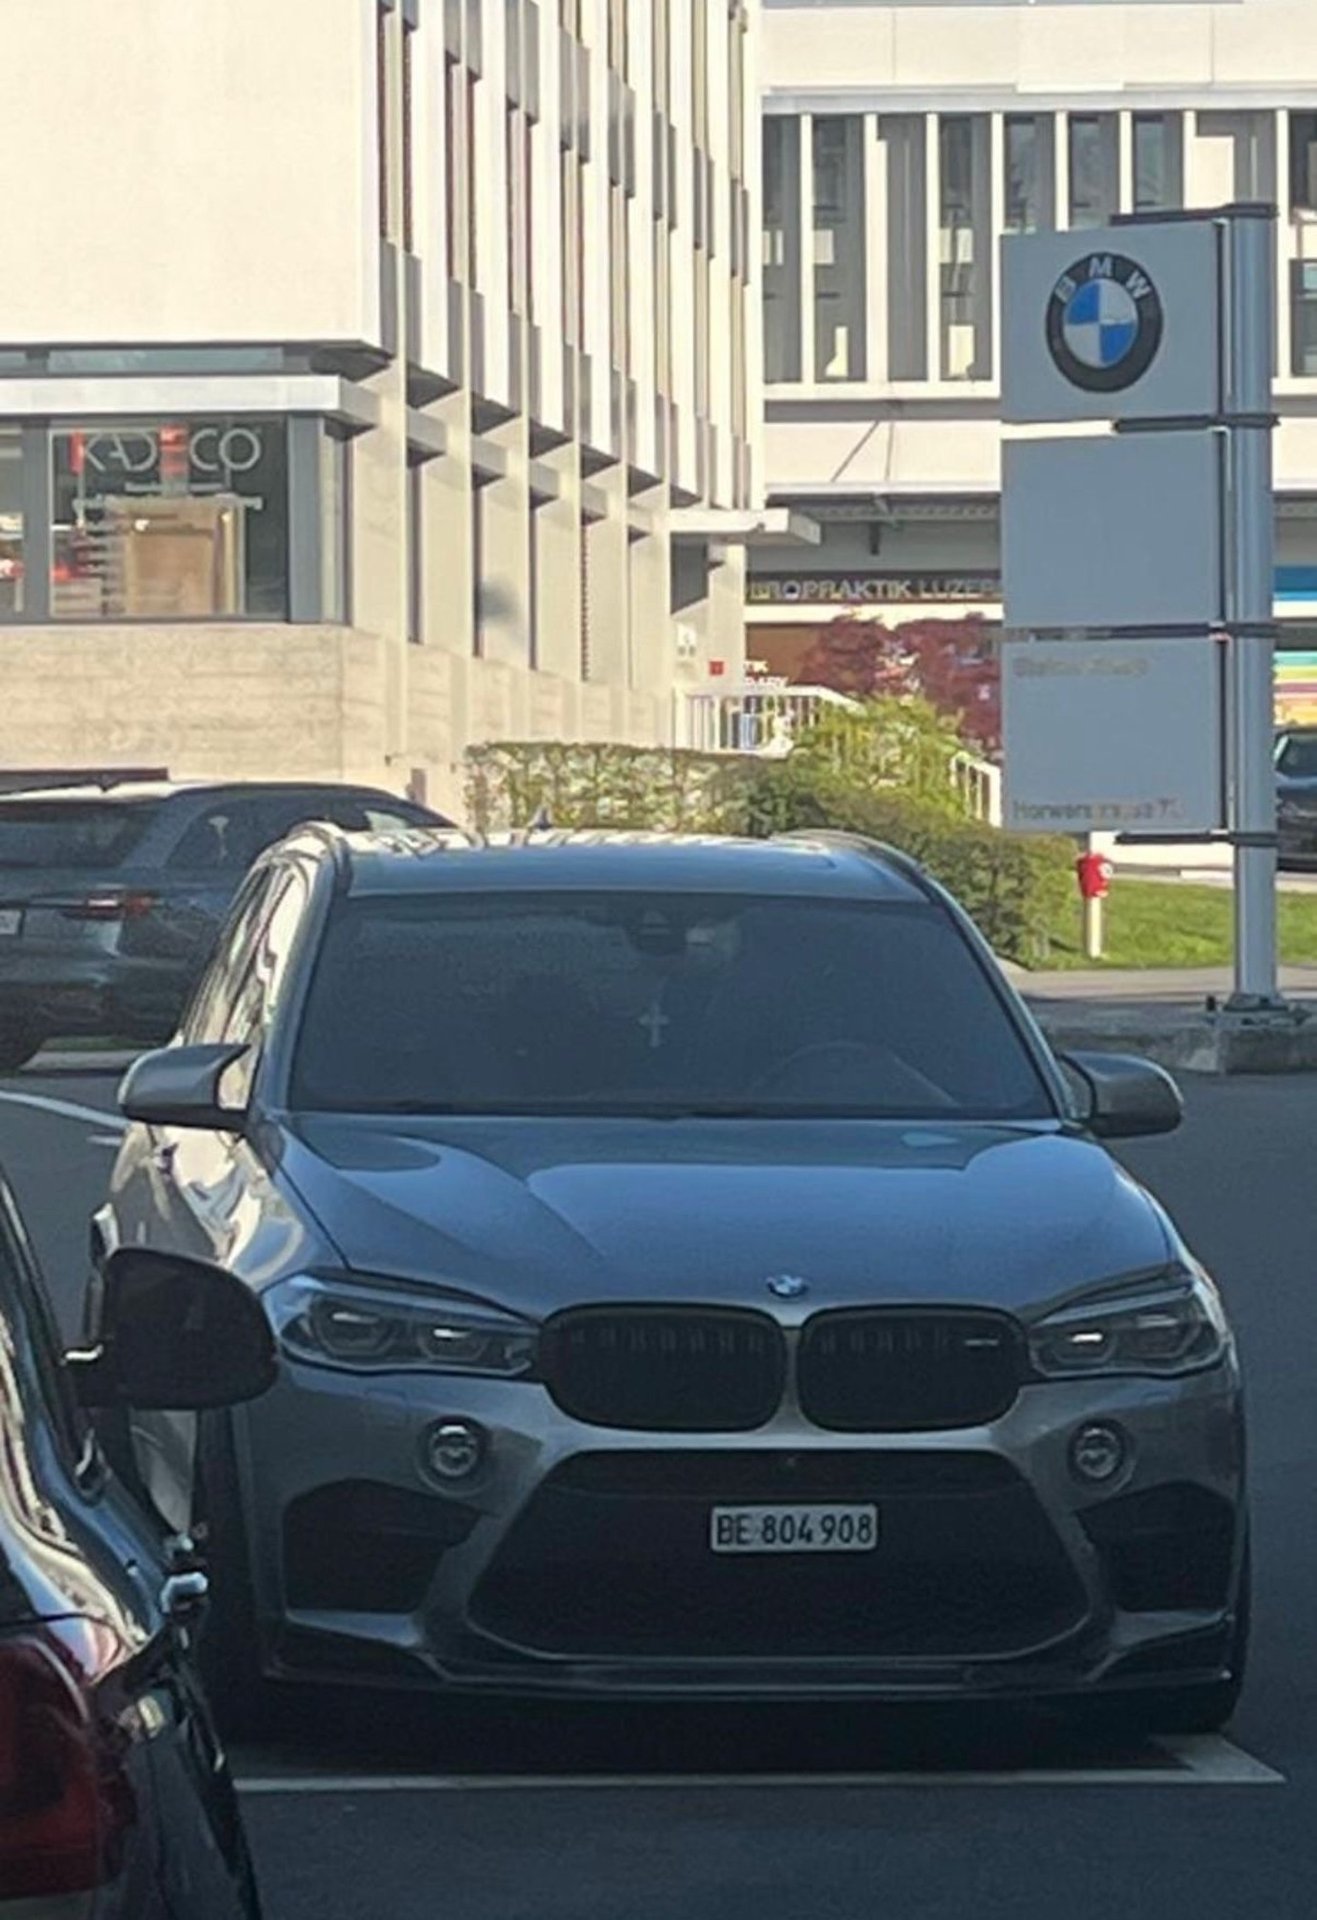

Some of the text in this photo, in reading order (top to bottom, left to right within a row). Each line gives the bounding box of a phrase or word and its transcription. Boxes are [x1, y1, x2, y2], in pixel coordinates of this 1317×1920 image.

[1055, 256, 1151, 302] BMW
[717, 1513, 873, 1545] BE 804 908
